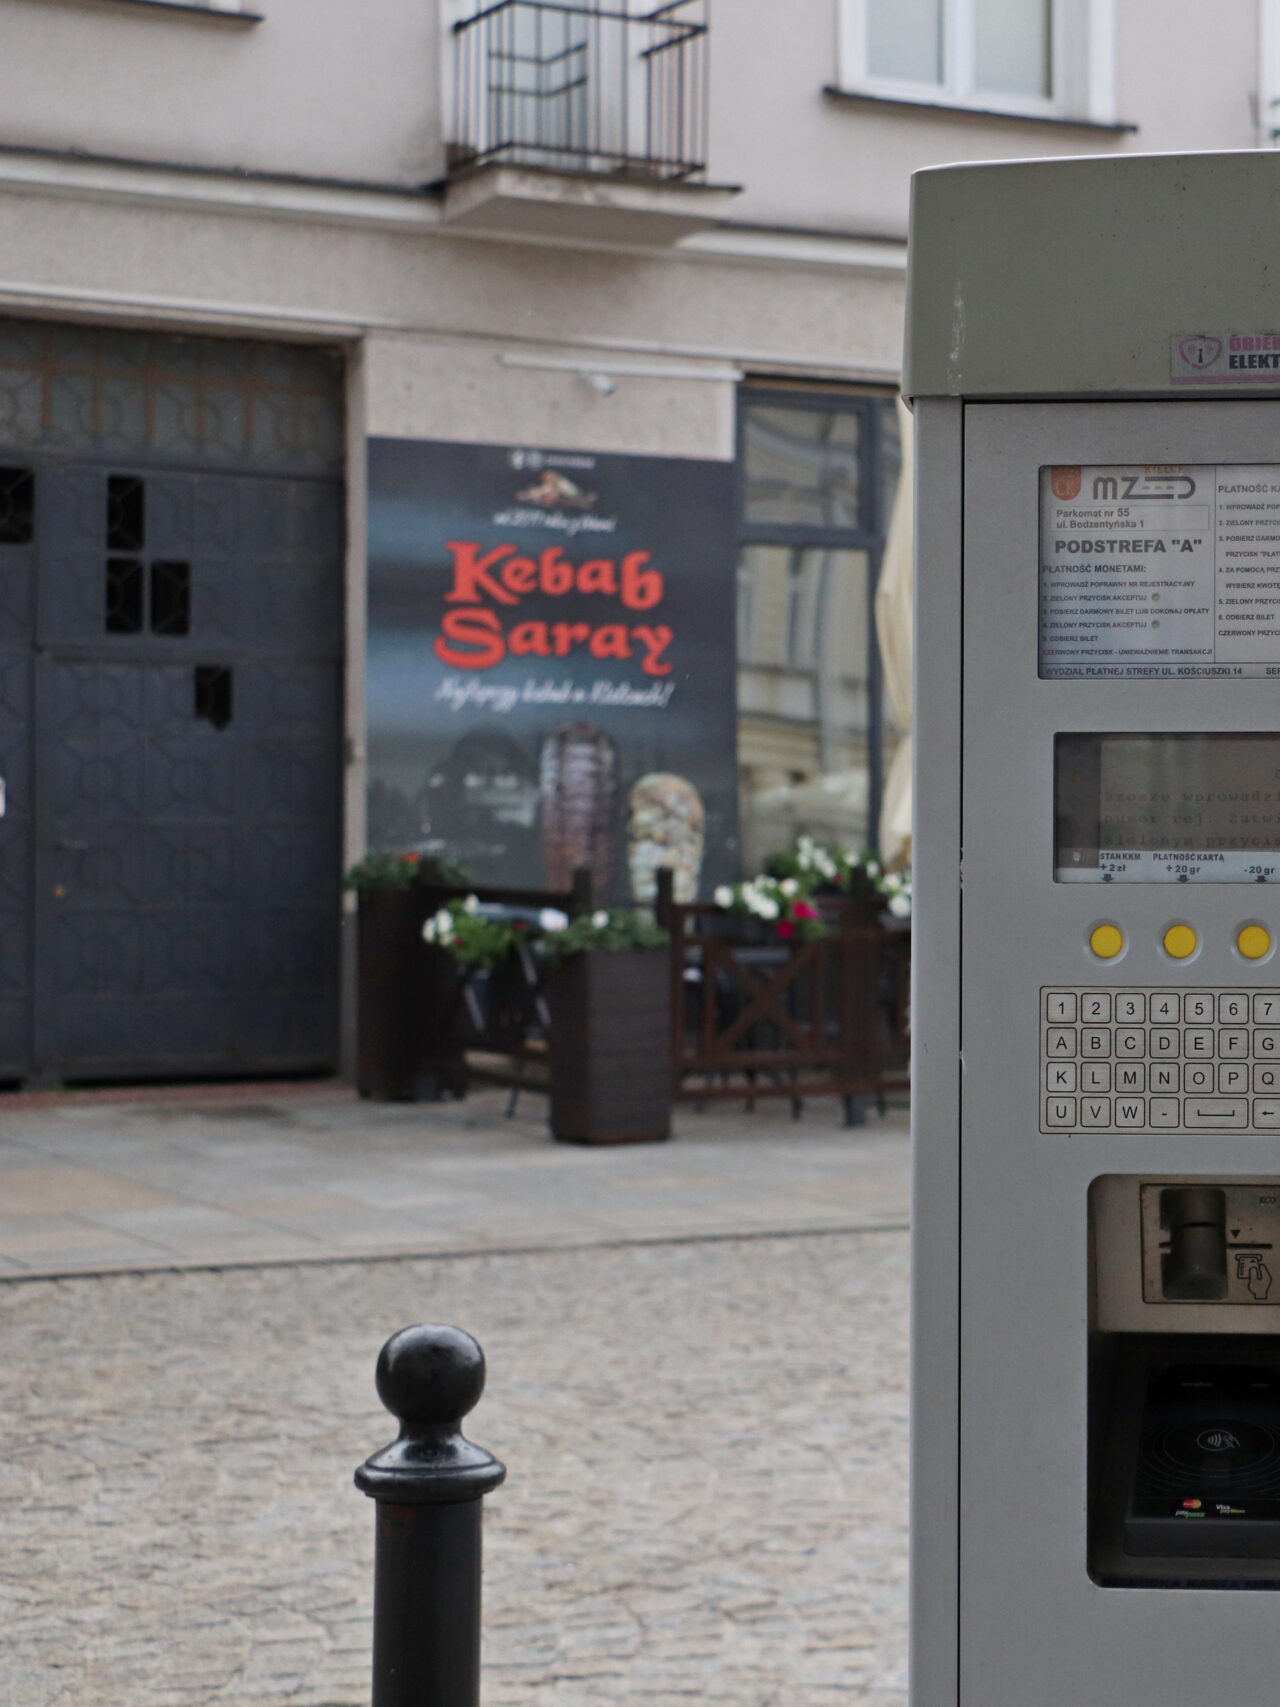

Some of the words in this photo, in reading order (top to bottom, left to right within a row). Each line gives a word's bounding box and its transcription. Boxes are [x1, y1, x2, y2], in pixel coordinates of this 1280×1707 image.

[1218, 484, 1268, 493] PŁATNOŚĆ
[1057, 509, 1101, 517] Parkomat
[1118, 508, 1129, 517] 55
[1070, 520, 1136, 530] Bodzentyńska
[1140, 520, 1143, 528] 1
[1055, 540, 1166, 553] PODSTREFA
[1171, 539, 1202, 553] "A"
[1043, 564, 1092, 573] PŁATNOŚĆ
[1095, 564, 1146, 572] MONETAMI:
[444, 541, 664, 610] Kebab
[433, 607, 673, 676] Saray
[1086, 667, 1124, 675] PŁATNEJ
[1127, 667, 1158, 675] STREFY
[1162, 667, 1175, 675] UL.
[1178, 666, 1231, 674] KOŚCIUSZKI
[1152, 852, 1196, 862] PŁATNOŚĆ
[1197, 853, 1225, 863] KARTĄ
[1059, 1002, 1064, 1014] 1
[1092, 1002, 1100, 1015] 2
[1126, 1002, 1134, 1015] 3
[1160, 1002, 1169, 1015] 4
[1195, 1002, 1203, 1015] 5
[1229, 1003, 1238, 1016] 6
[1264, 1003, 1272, 1015] 7
[1056, 1036, 1067, 1049] A
[1091, 1037, 1101, 1049] B
[1125, 1037, 1136, 1050] C
[1159, 1037, 1170, 1050] D
[1194, 1037, 1204, 1050] E
[1229, 1037, 1238, 1050] F
[1262, 1037, 1274, 1050] G
[1057, 1071, 1067, 1084] K
[1092, 1072, 1100, 1084] L
[1124, 1071, 1136, 1084] M
[1159, 1072, 1169, 1084] N
[1193, 1072, 1205, 1085] O
[1229, 1072, 1239, 1085] P
[1262, 1072, 1274, 1085] Q
[1056, 1106, 1066, 1118] U
[1090, 1106, 1101, 1119] V
[1122, 1106, 1137, 1119] W
